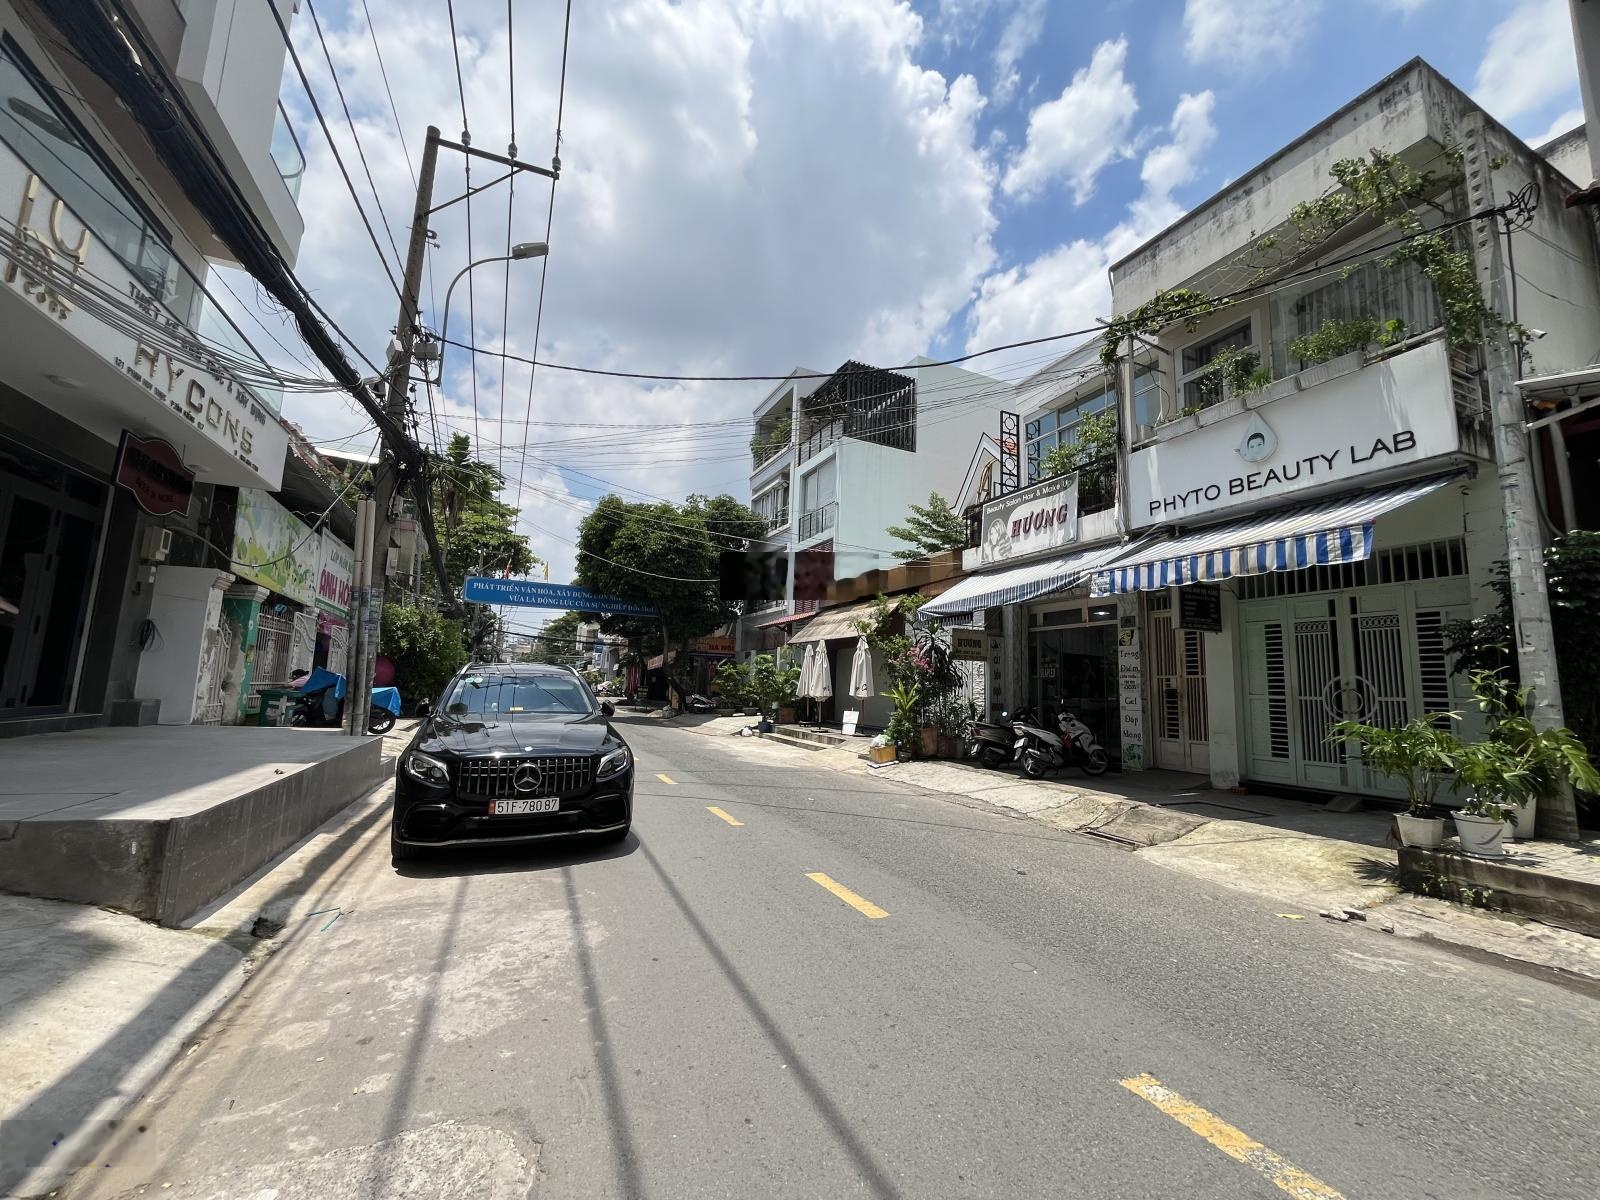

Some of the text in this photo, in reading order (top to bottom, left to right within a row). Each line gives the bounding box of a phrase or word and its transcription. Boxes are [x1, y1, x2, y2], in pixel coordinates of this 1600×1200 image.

[1149, 430, 1417, 516] PHYTO BEAUTY LAB
[986, 503, 1005, 514] Beauty
[1006, 497, 1021, 507] Salon
[1022, 492, 1034, 502] Hair
[1042, 485, 1061, 494] Make
[1062, 480, 1072, 489] Up
[1011, 504, 1068, 538] HƯƠNG
[473, 582, 495, 590] PHÁT
[495, 583, 519, 592] TRIỂN
